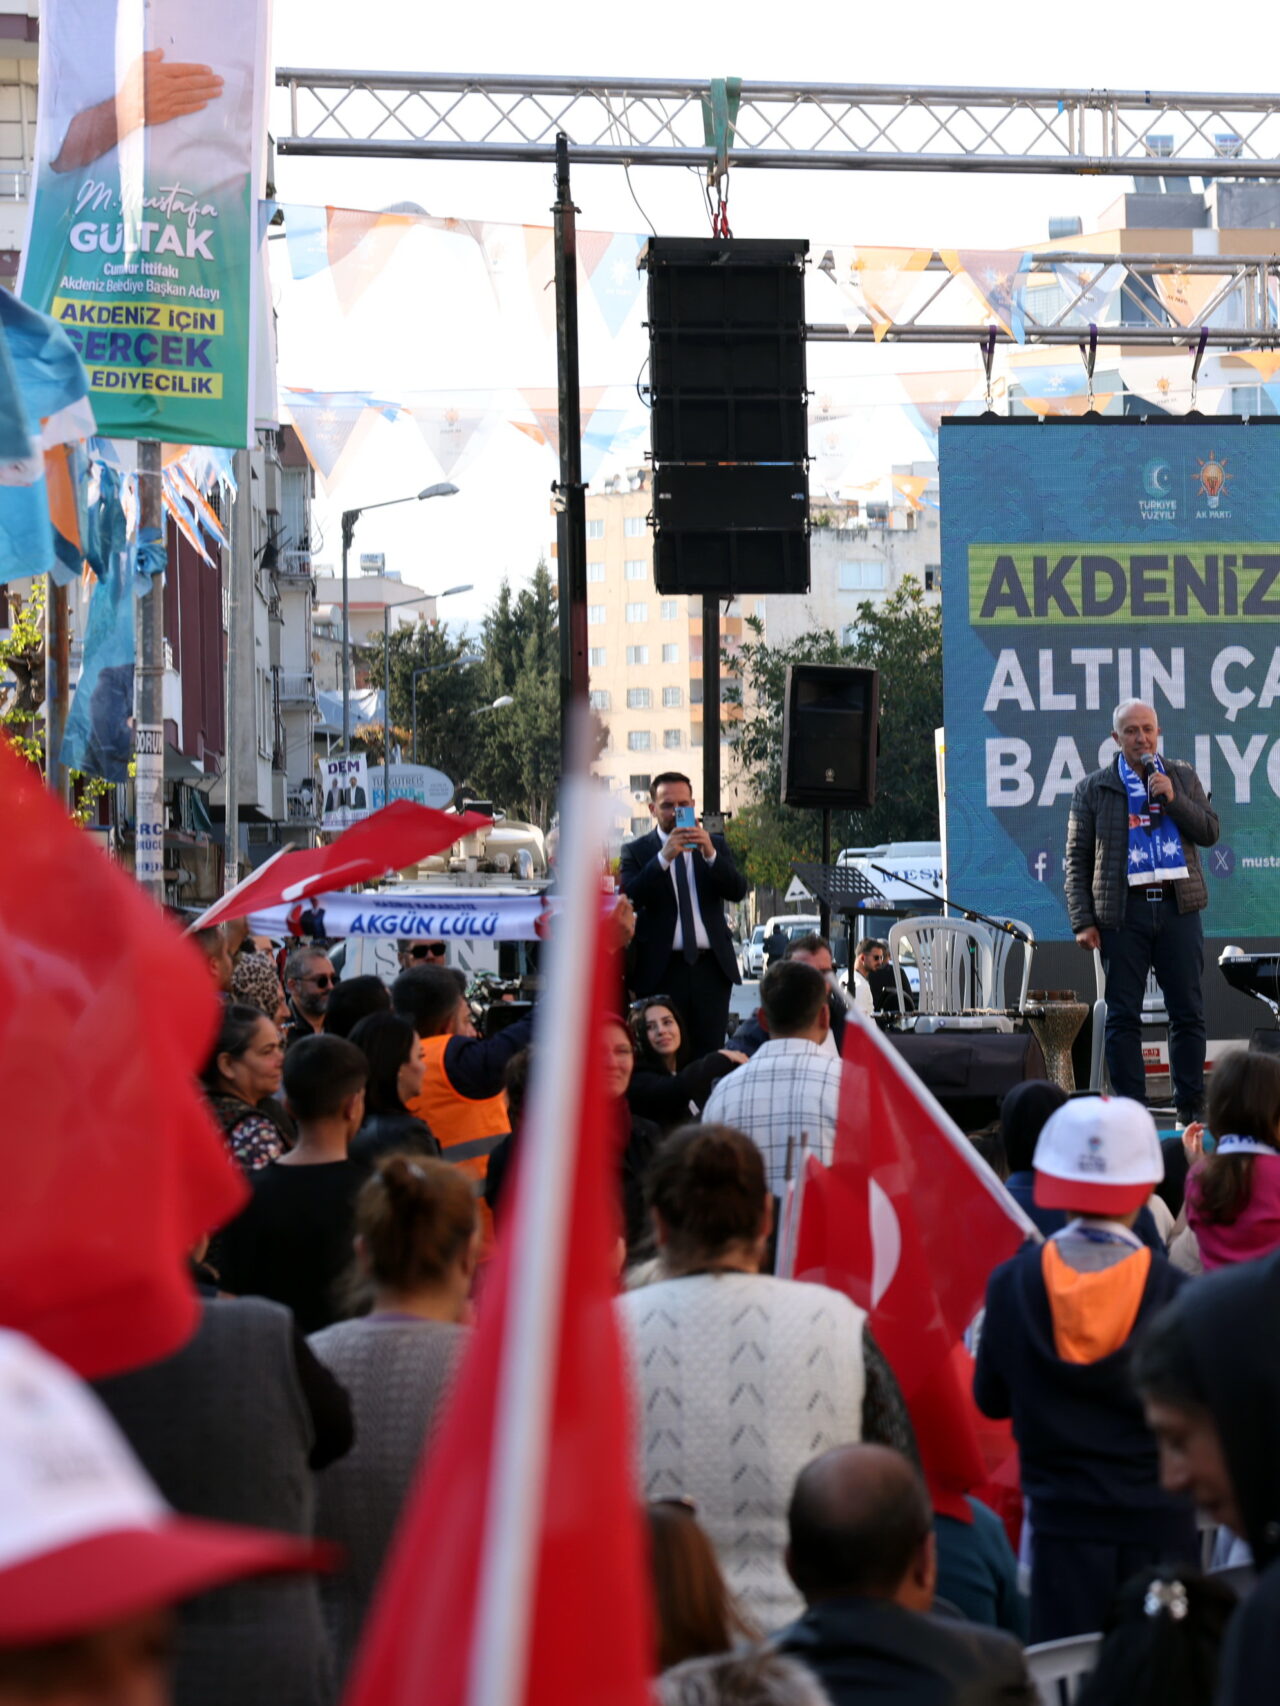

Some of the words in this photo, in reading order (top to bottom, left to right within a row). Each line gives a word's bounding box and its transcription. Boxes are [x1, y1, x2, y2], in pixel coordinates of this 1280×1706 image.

[69, 221, 215, 261] GÜLTAK
[60, 275, 104, 293] Akdeniz
[146, 279, 186, 298] Başkan
[188, 285, 220, 302] Adayı
[60, 303, 161, 327] AKDENİZ
[168, 310, 216, 333] İÇİN
[91, 371, 213, 394] EDİYECİLİK
[983, 646, 1185, 712] ALTIN
[328, 761, 360, 775] DEM
[350, 911, 434, 934] AKGÜN
[439, 912, 499, 936] LÜLÜ
